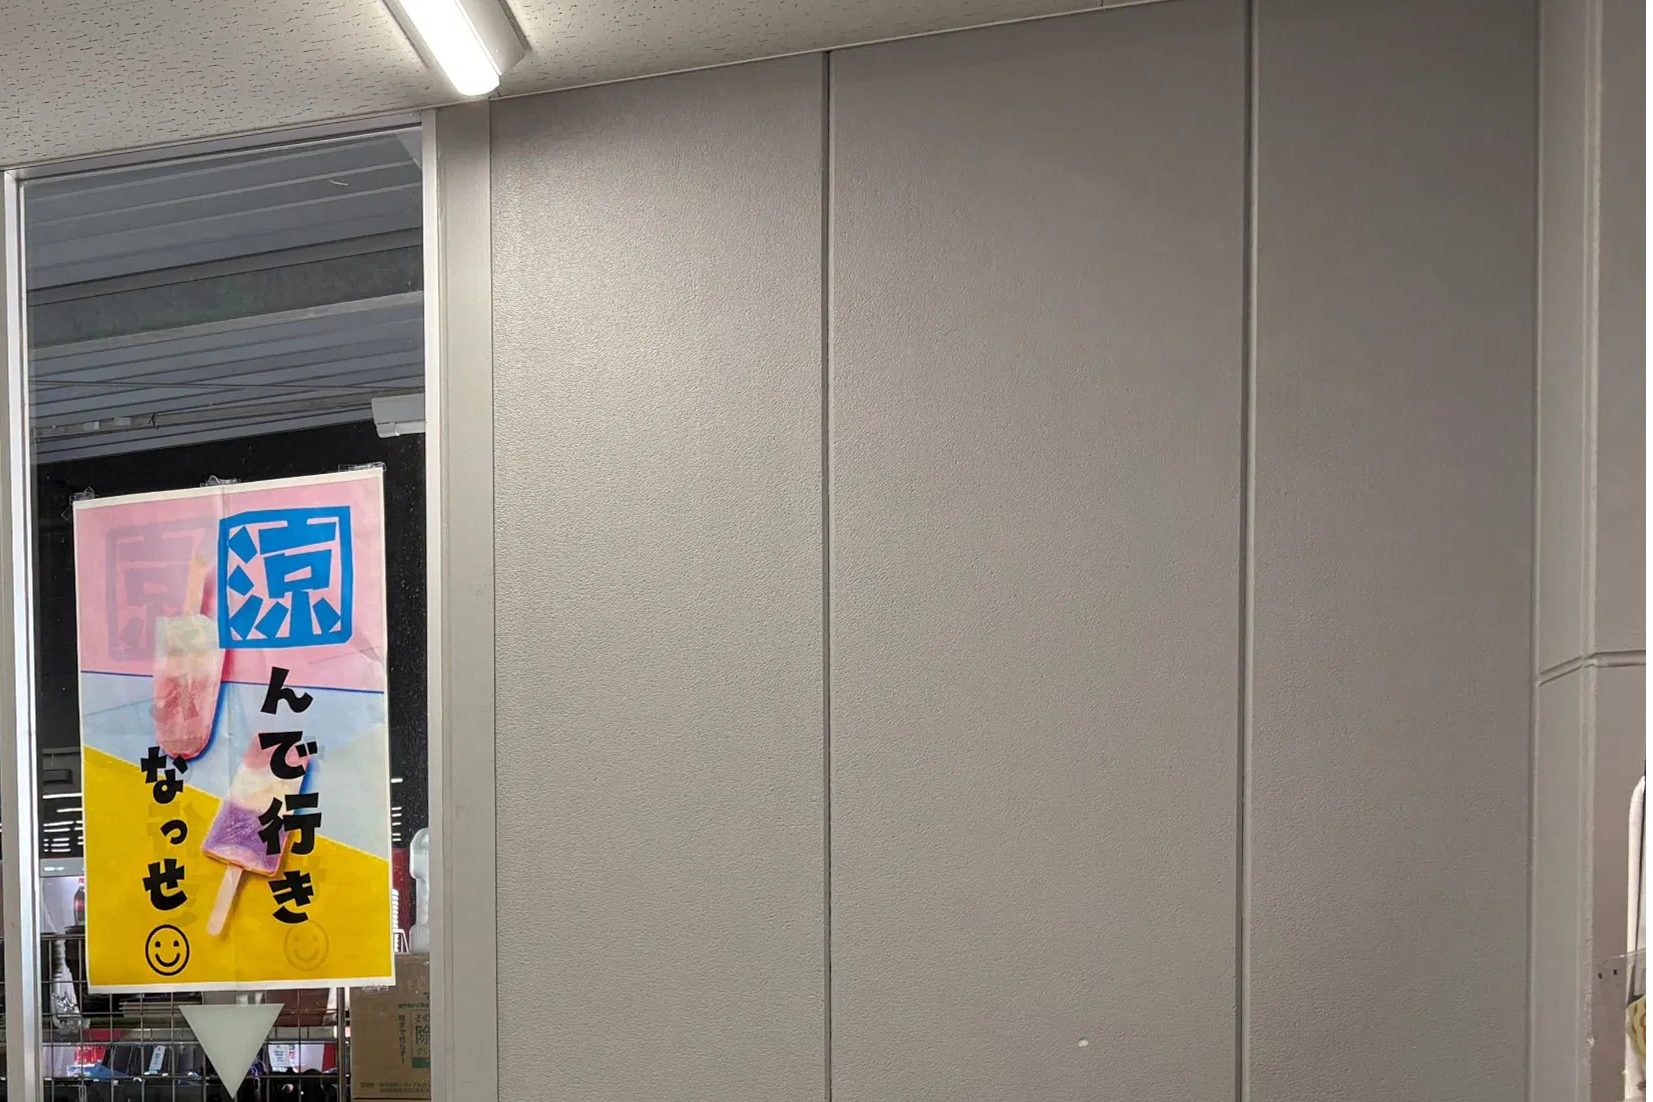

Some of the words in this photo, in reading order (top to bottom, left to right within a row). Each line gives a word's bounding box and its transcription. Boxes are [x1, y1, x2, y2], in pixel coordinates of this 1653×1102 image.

[228, 525, 343, 641] 涼
[140, 746, 189, 911] なっせ
[258, 666, 323, 925] んで行き
